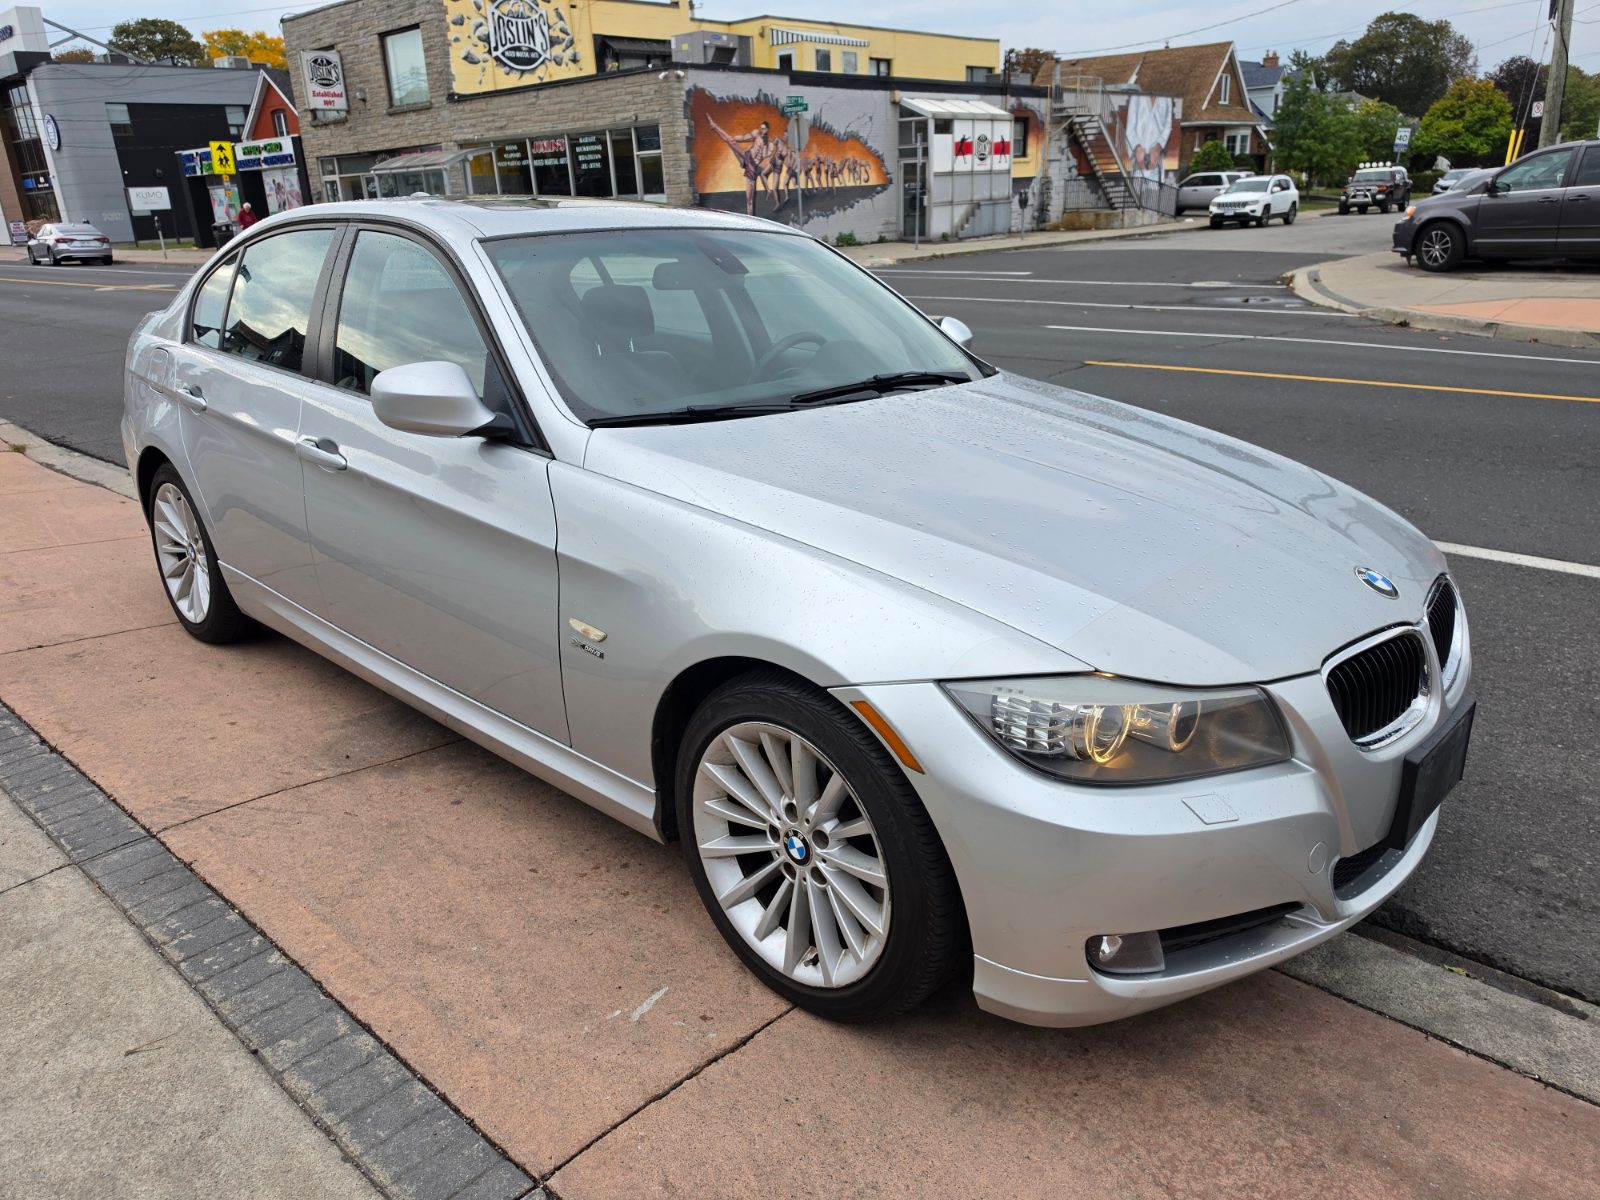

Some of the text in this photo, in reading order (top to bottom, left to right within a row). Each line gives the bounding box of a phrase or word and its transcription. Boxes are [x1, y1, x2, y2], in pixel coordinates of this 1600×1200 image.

[491, 11, 548, 52] JOSLIN'S
[309, 62, 340, 81] JOSLIN'S
[312, 90, 343, 98] Established
[1397, 134, 1409, 142] 40
[136, 191, 163, 199] KUMO
[783, 829, 804, 844] BMW
